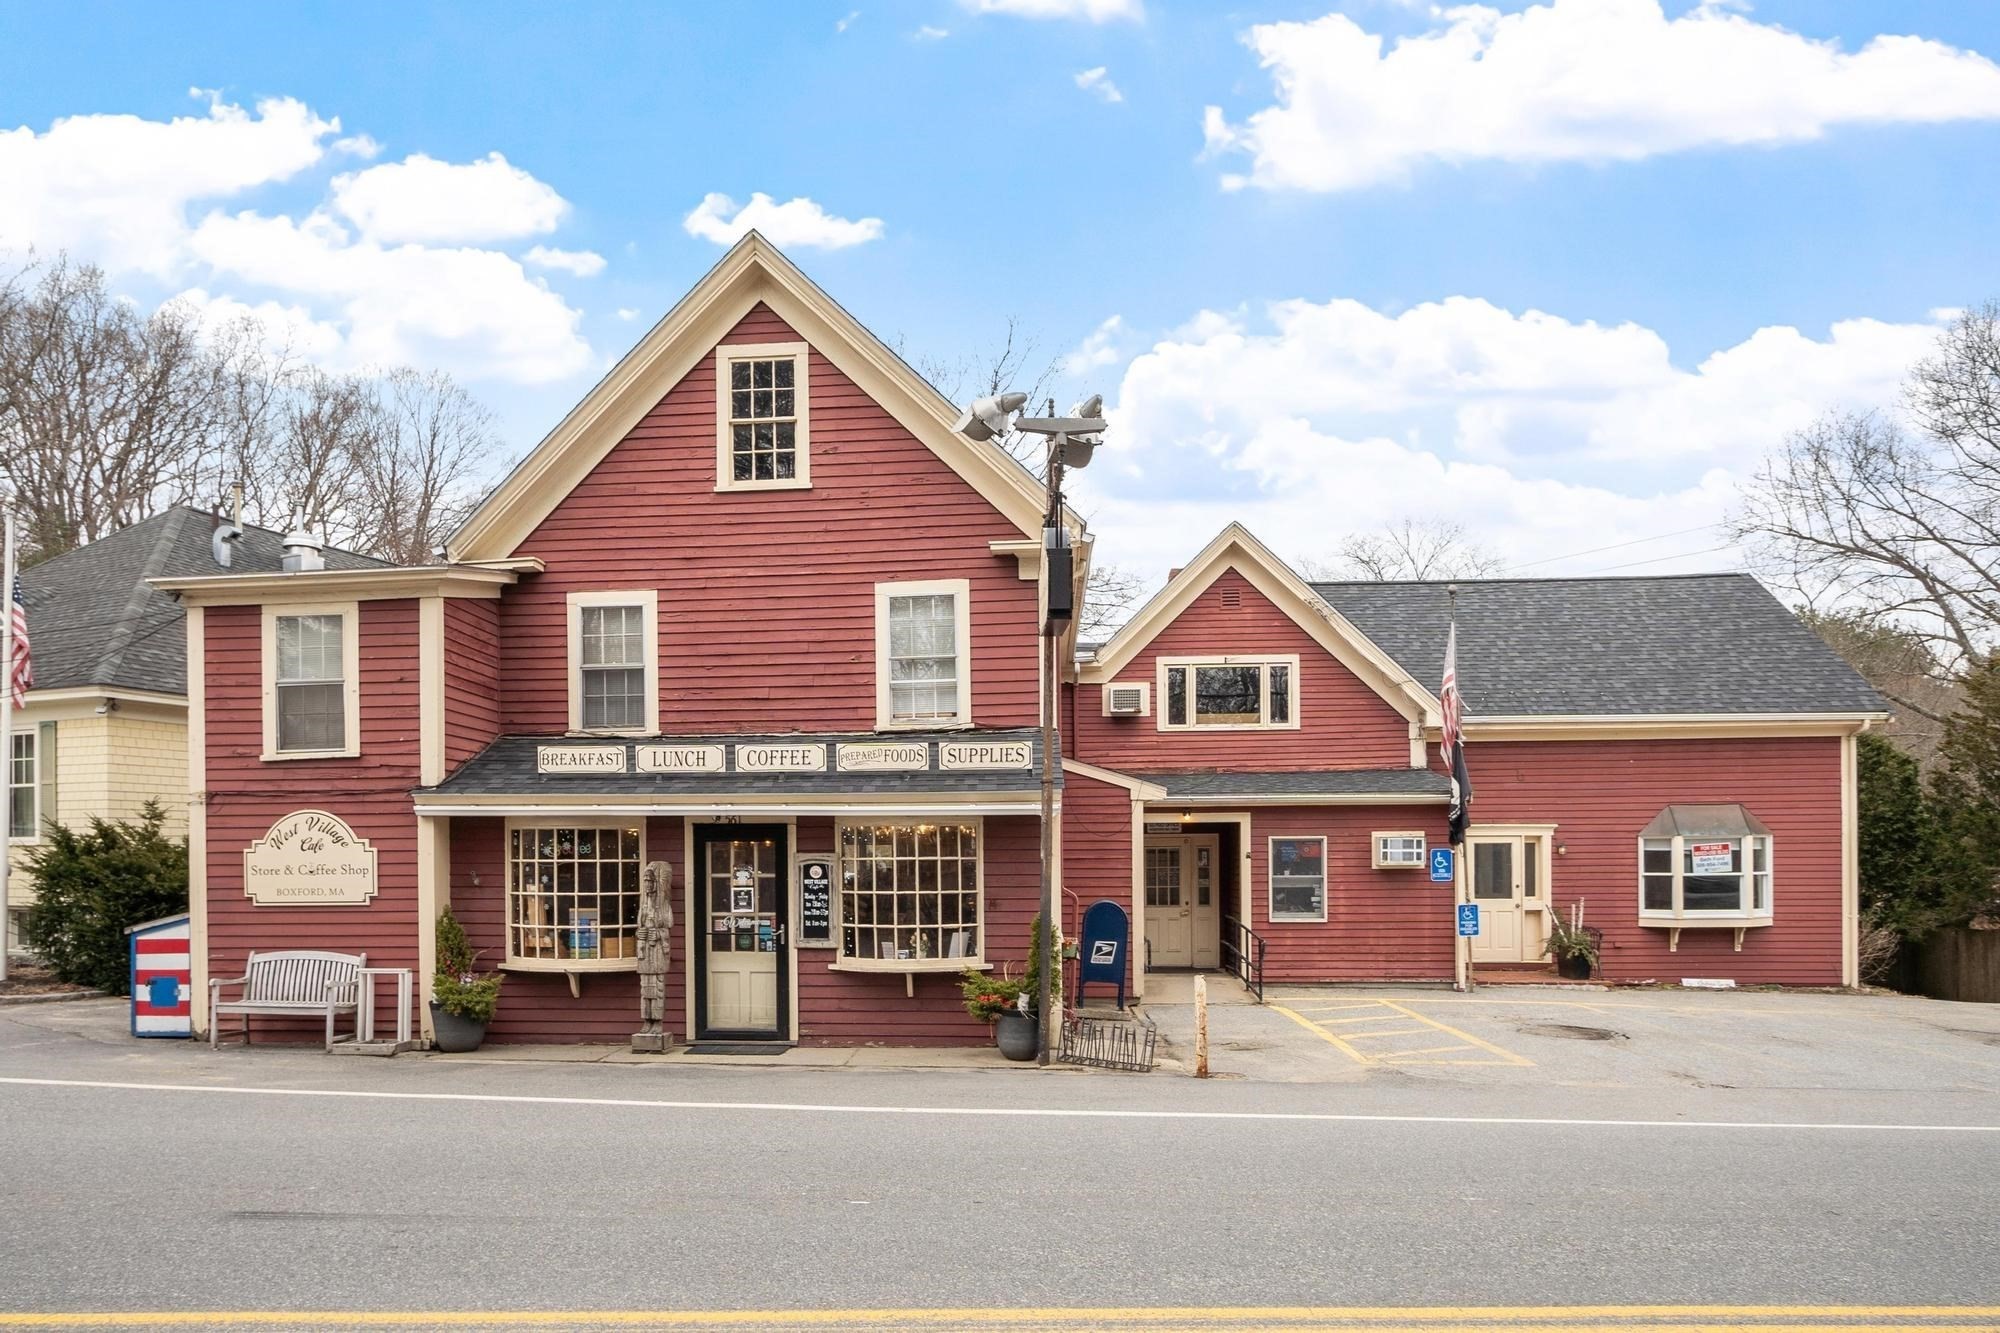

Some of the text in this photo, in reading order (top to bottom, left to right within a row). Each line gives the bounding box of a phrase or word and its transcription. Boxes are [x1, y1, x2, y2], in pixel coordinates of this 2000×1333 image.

[541, 752, 622, 766] BREAKFAST
[652, 750, 706, 767] LUNCH
[746, 749, 812, 766] COFFEE
[840, 748, 924, 763] PREPARED FOODS
[947, 747, 1025, 763] SUPPLIES
[270, 816, 350, 850] West Village
[251, 865, 280, 876] Store
[284, 865, 294, 876] &
[340, 864, 369, 878] Shop
[276, 888, 345, 897] BOXFORD, MA
